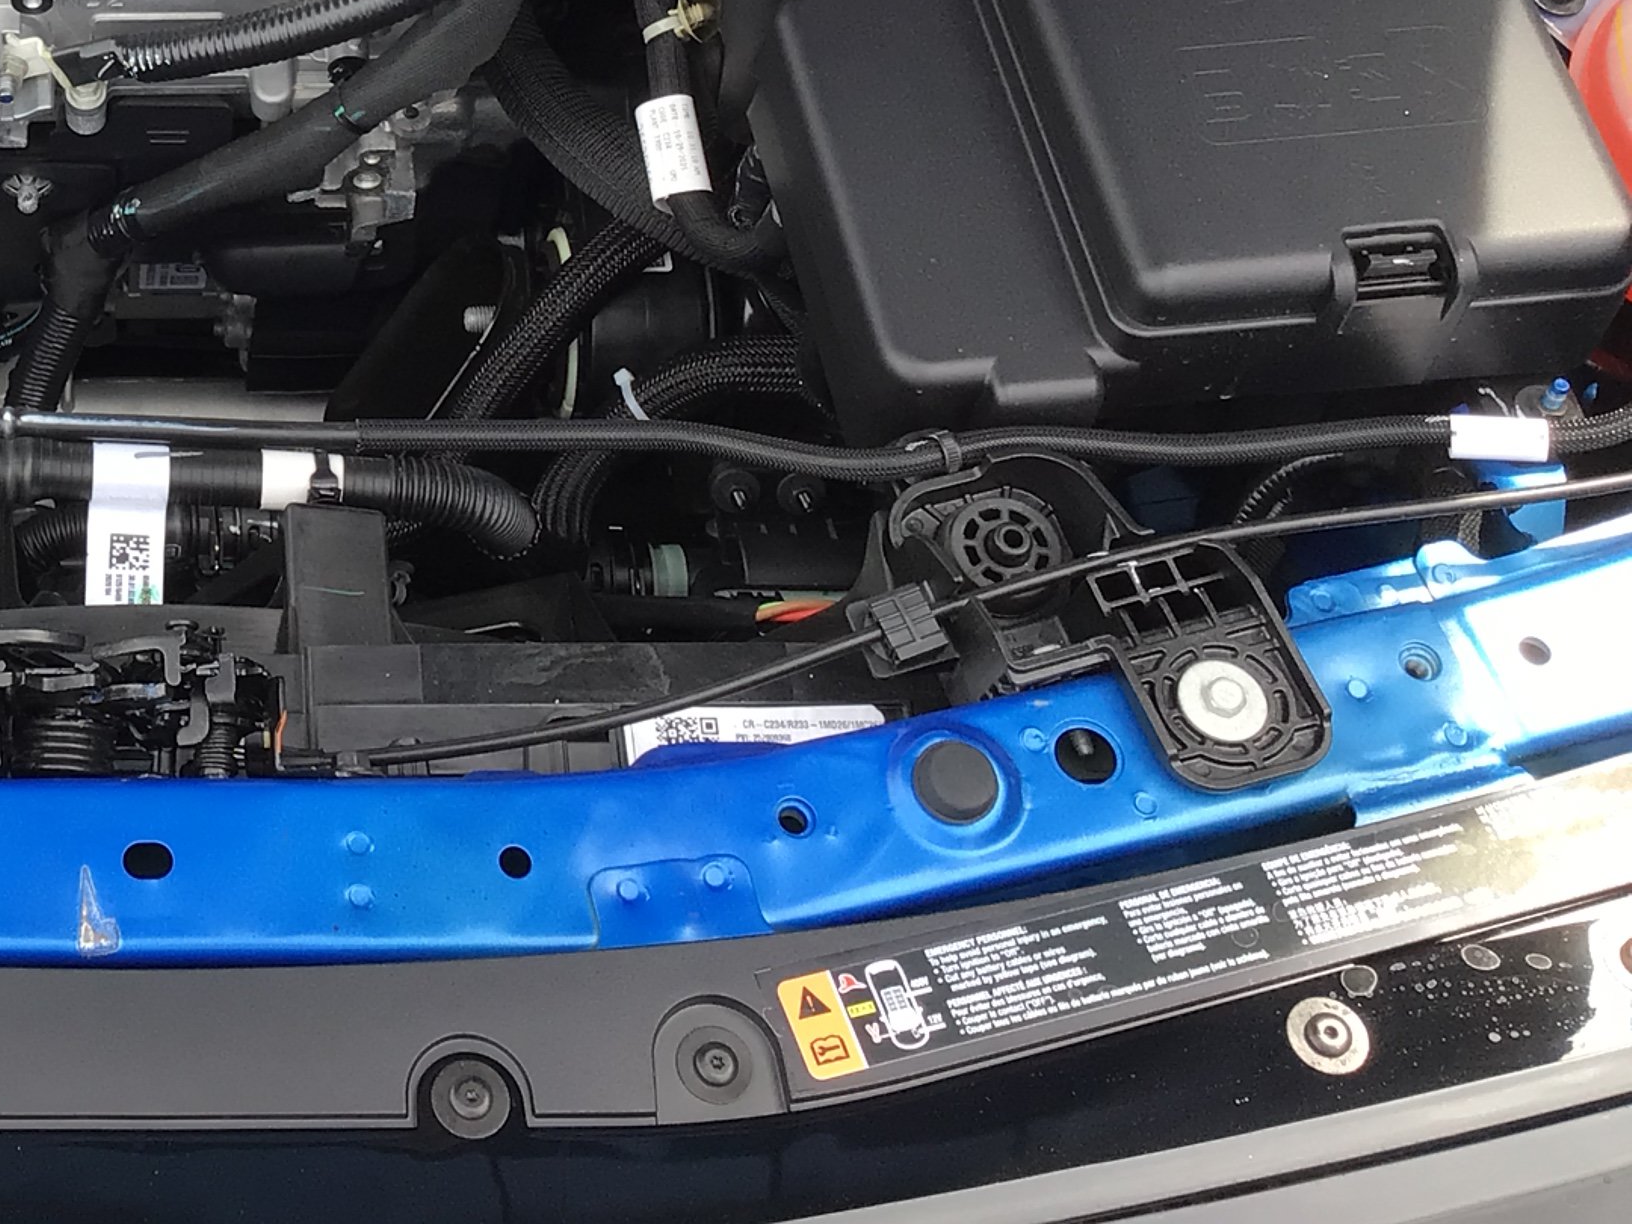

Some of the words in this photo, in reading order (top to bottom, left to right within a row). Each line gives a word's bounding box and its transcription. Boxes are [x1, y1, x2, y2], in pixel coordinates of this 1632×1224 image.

[1118, 893, 1159, 909] PERSONAL
[1158, 889, 1170, 899] DE
[924, 938, 974, 958] EMERGENCY
[975, 926, 1027, 944] PERSONNEL:
[939, 953, 960, 967] help
[958, 947, 981, 962] avoid
[981, 938, 1017, 954] personal
[1016, 933, 1040, 944] injury
[1061, 916, 1107, 932] emergency,
[940, 963, 959, 975] Turn
[959, 955, 990, 969] ignition
[944, 972, 960, 984] Cut
[960, 969, 977, 981] any
[975, 962, 1005, 978] battery
[1005, 955, 1032, 967] cables
[1042, 946, 1066, 957] wires
[950, 977, 981, 991] marked
[993, 968, 1019, 982] yellow
[1019, 963, 1039, 973] tape
[946, 990, 991, 1008] PERSONNEL
